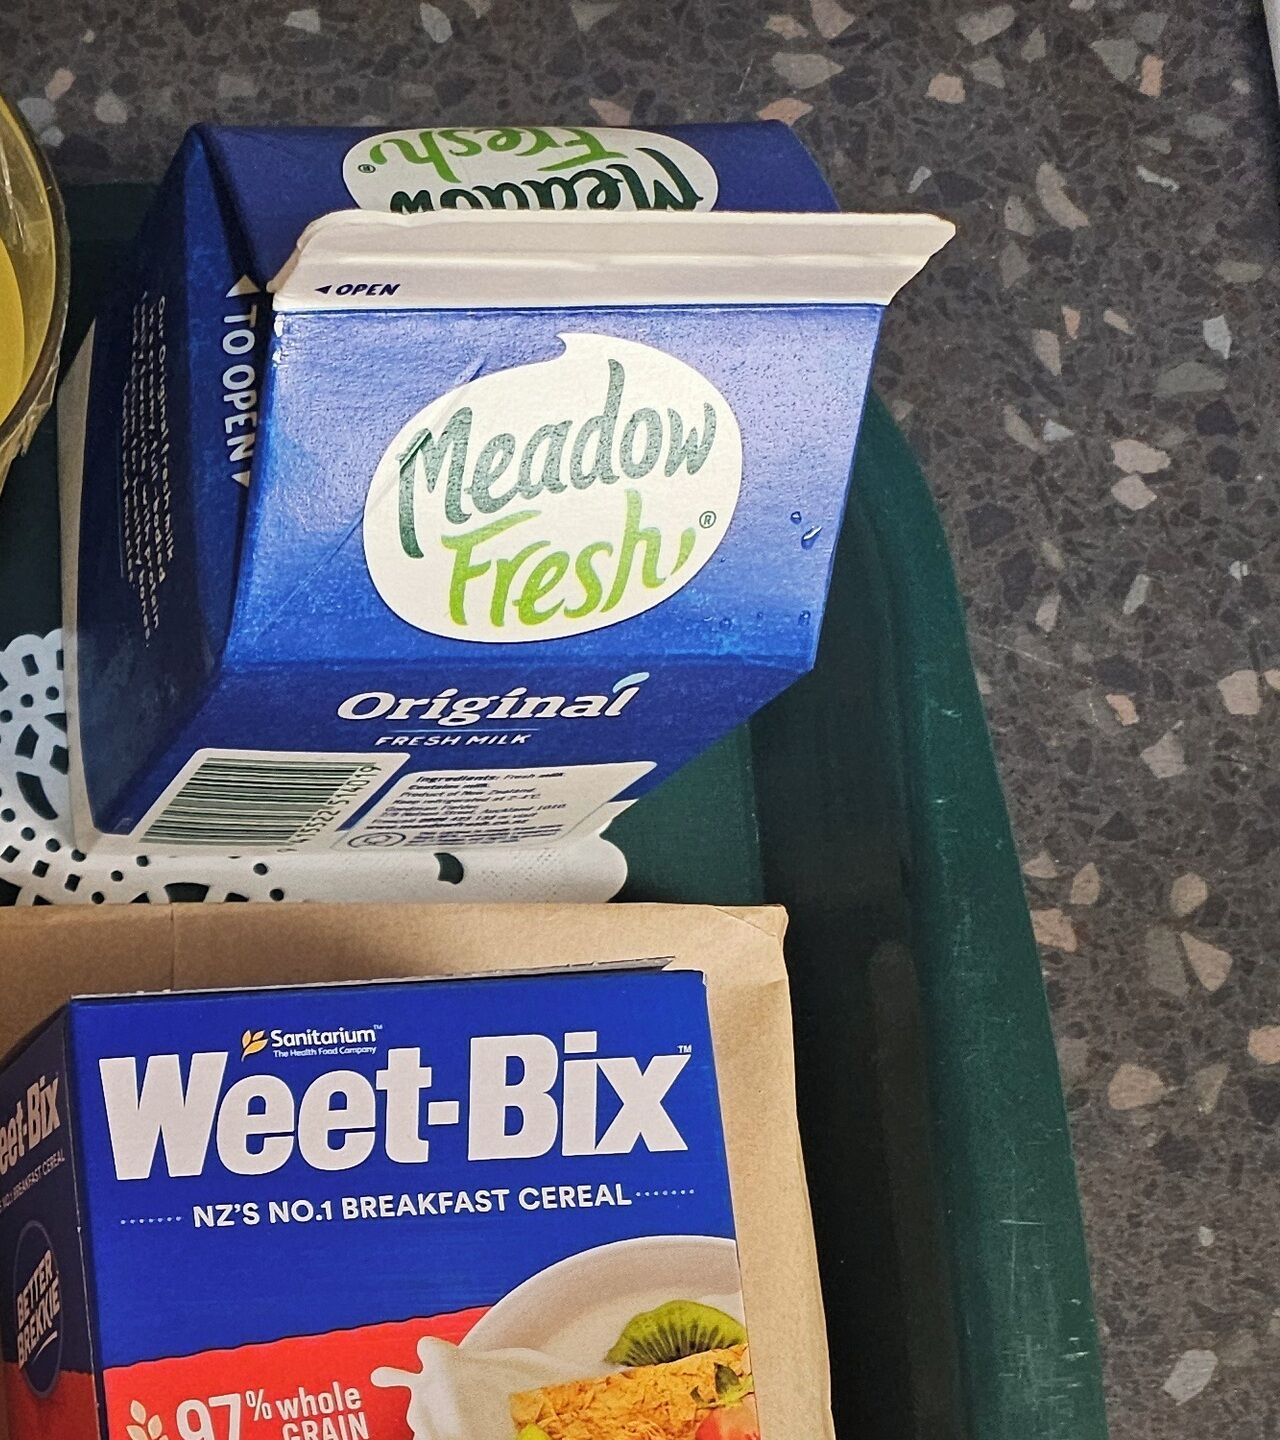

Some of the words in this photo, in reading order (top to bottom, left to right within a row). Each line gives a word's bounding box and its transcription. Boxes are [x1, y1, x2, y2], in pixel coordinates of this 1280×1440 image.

[335, 283, 401, 297] OPEN
[224, 304, 257, 356] TO
[223, 364, 258, 465] OPEN
[396, 359, 718, 559] Meadow
[441, 489, 700, 629] Fresh
[337, 686, 641, 727] Original
[373, 735, 464, 747] FRESH
[469, 733, 533, 746] MILK
[270, 1027, 377, 1048] Sanitarium
[318, 1047, 338, 1055] Food
[339, 1046, 377, 1055] Company
[99, 1031, 691, 1180] Weet-Bix
[193, 1200, 260, 1228] NZ'S
[268, 1196, 333, 1224] NO.1
[342, 1187, 510, 1220] BREAKFAST
[517, 1183, 632, 1210] CEREAL
[17, 1249, 53, 1330] BETTER
[17, 1276, 61, 1370] BREKKIE
[276, 1381, 362, 1421] whole
